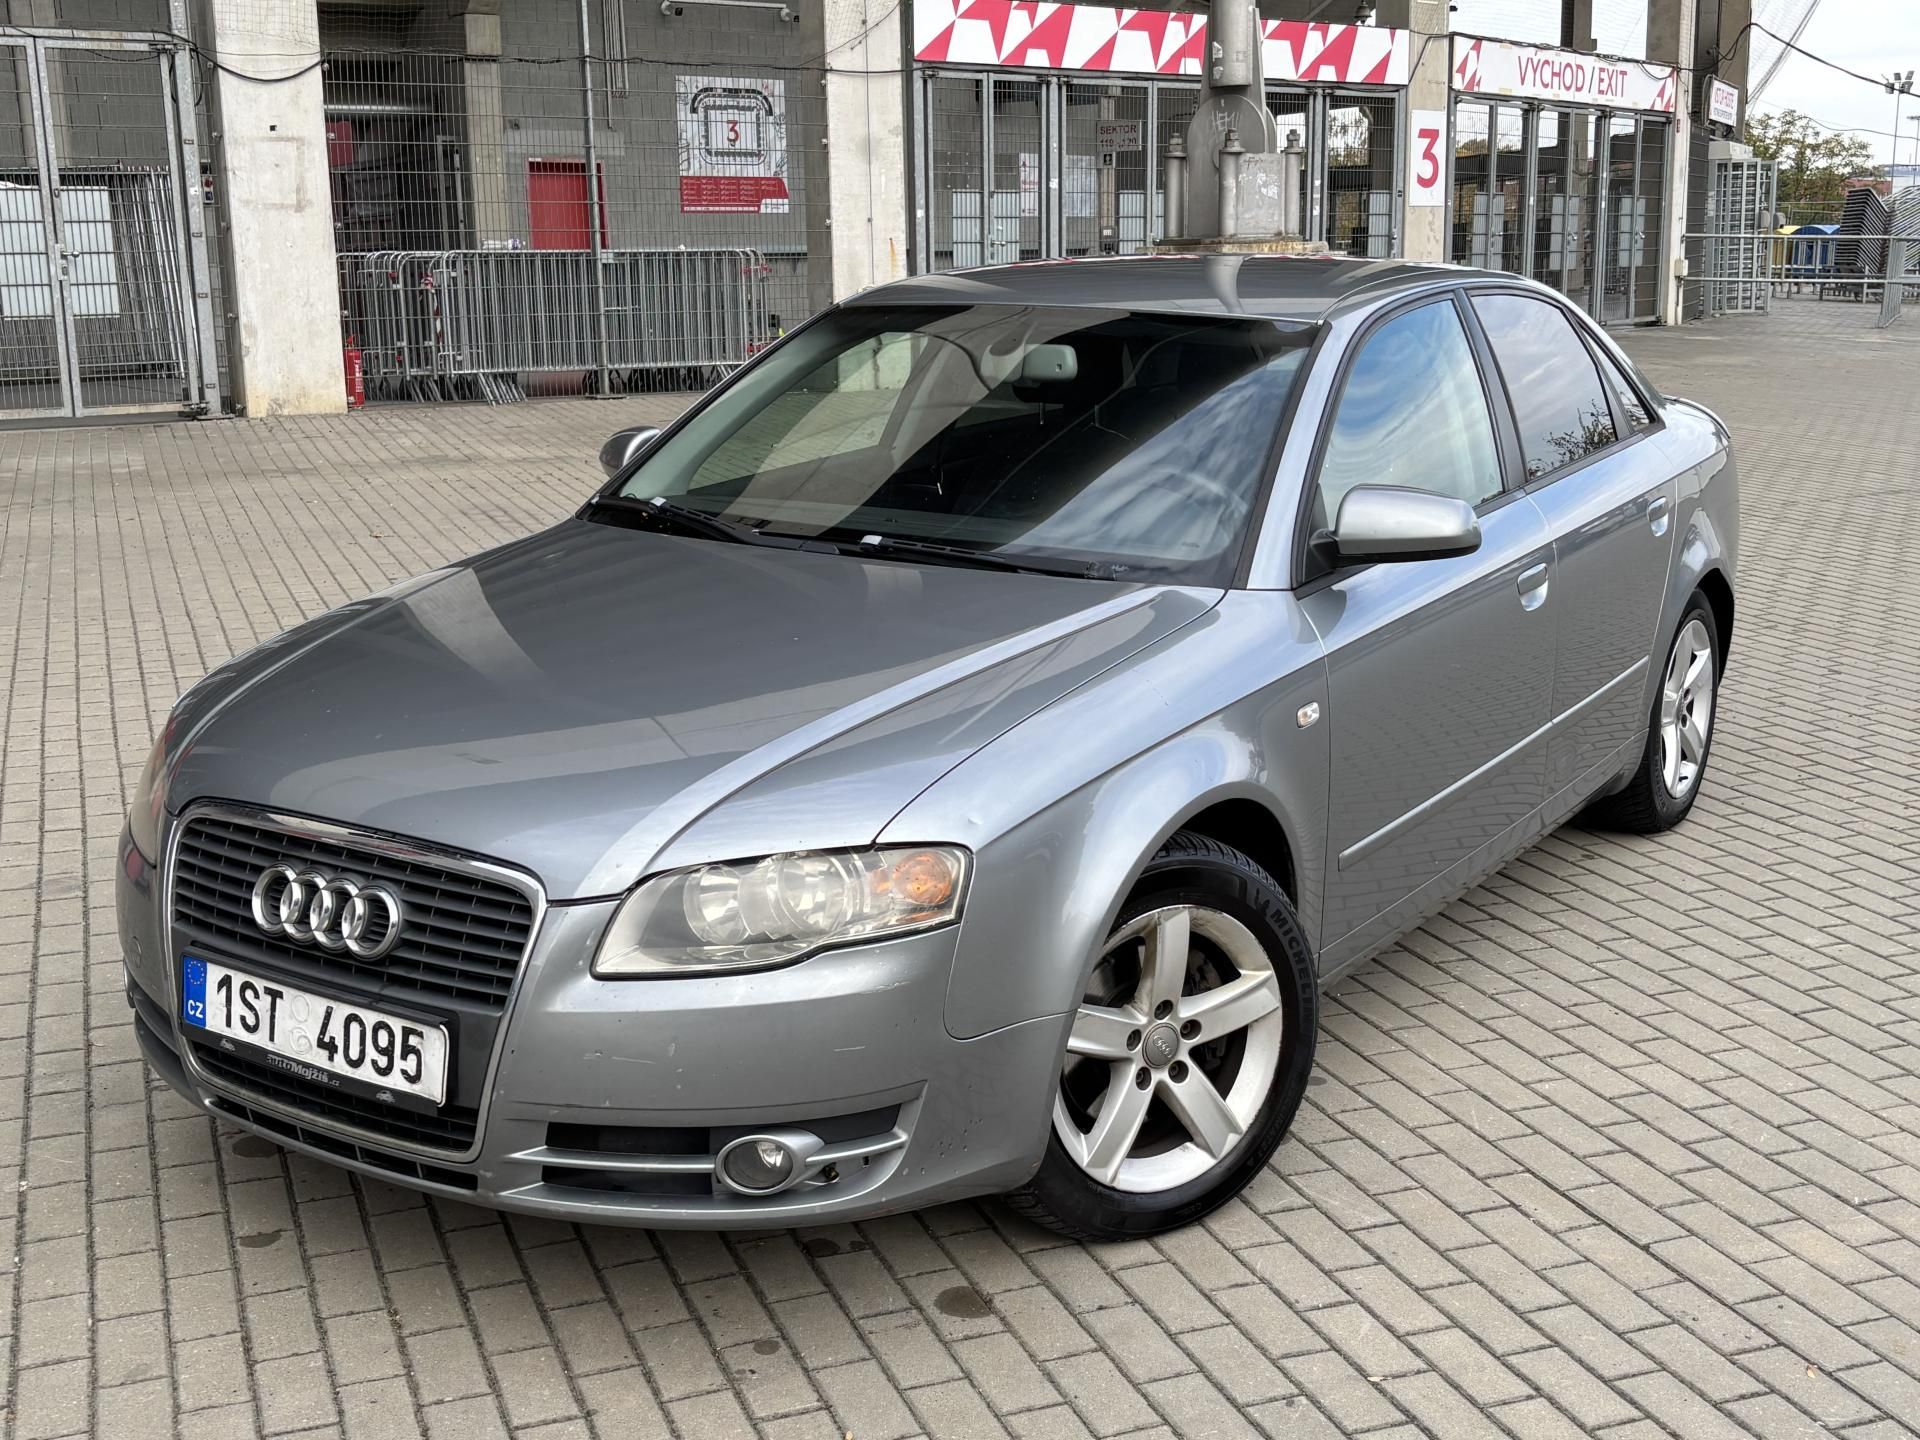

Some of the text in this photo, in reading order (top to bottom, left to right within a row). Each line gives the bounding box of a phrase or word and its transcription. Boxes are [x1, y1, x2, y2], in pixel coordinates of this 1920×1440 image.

[1518, 50, 1585, 92] VÝCHOD
[1597, 67, 1628, 98] EXIT
[727, 120, 739, 142] 3
[1100, 125, 1137, 134] SEKTOR
[1417, 128, 1440, 188] 3
[1270, 908, 1316, 1031] MICHELIN
[187, 999, 204, 1018] CZ
[216, 973, 424, 1084] 1ST 4095
